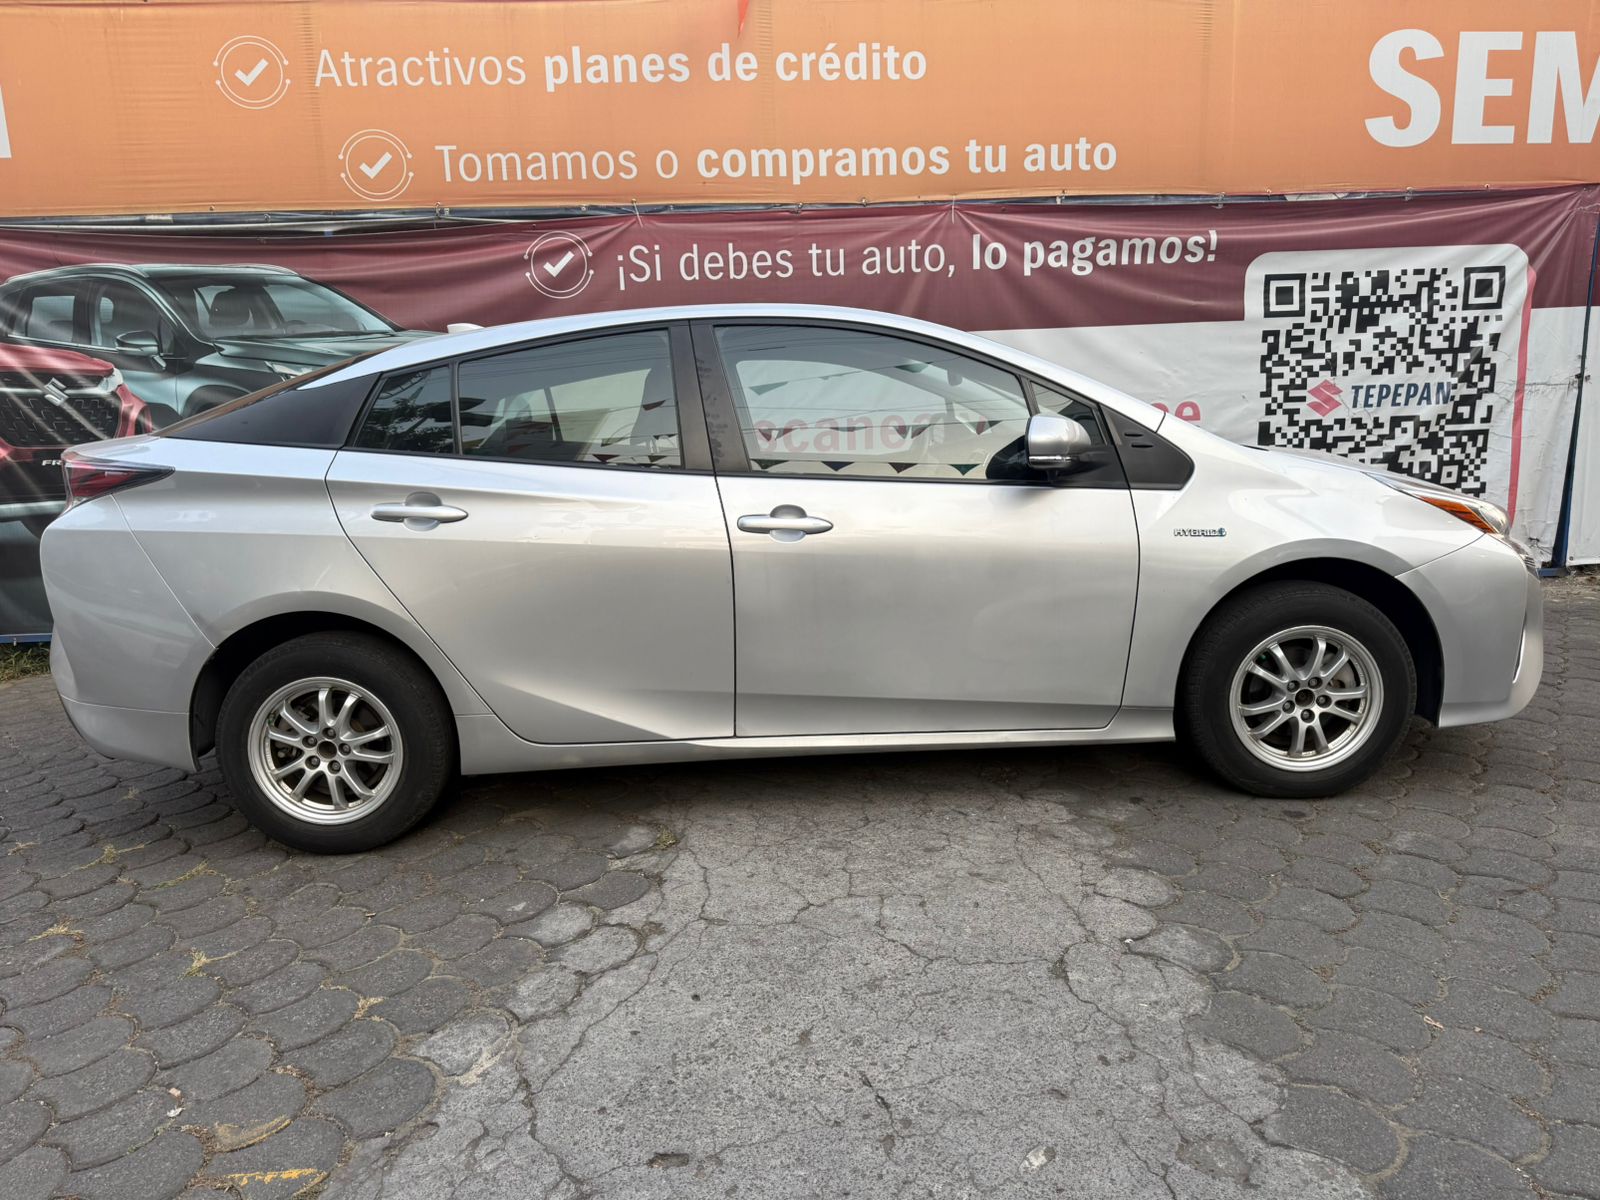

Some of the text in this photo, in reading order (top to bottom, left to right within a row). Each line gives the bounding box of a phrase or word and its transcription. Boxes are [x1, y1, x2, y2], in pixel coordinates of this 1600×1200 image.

[314, 42, 927, 93] Atractivos planes de crédito
[1365, 28, 1600, 148] SEM
[435, 136, 1118, 186] Tomamos o compramos tu auto
[617, 229, 1218, 291] ¡Si debes tu auto, lo pagamos!
[1351, 381, 1451, 409] TEPEPAN
[1173, 528, 1219, 537] HYBRID
